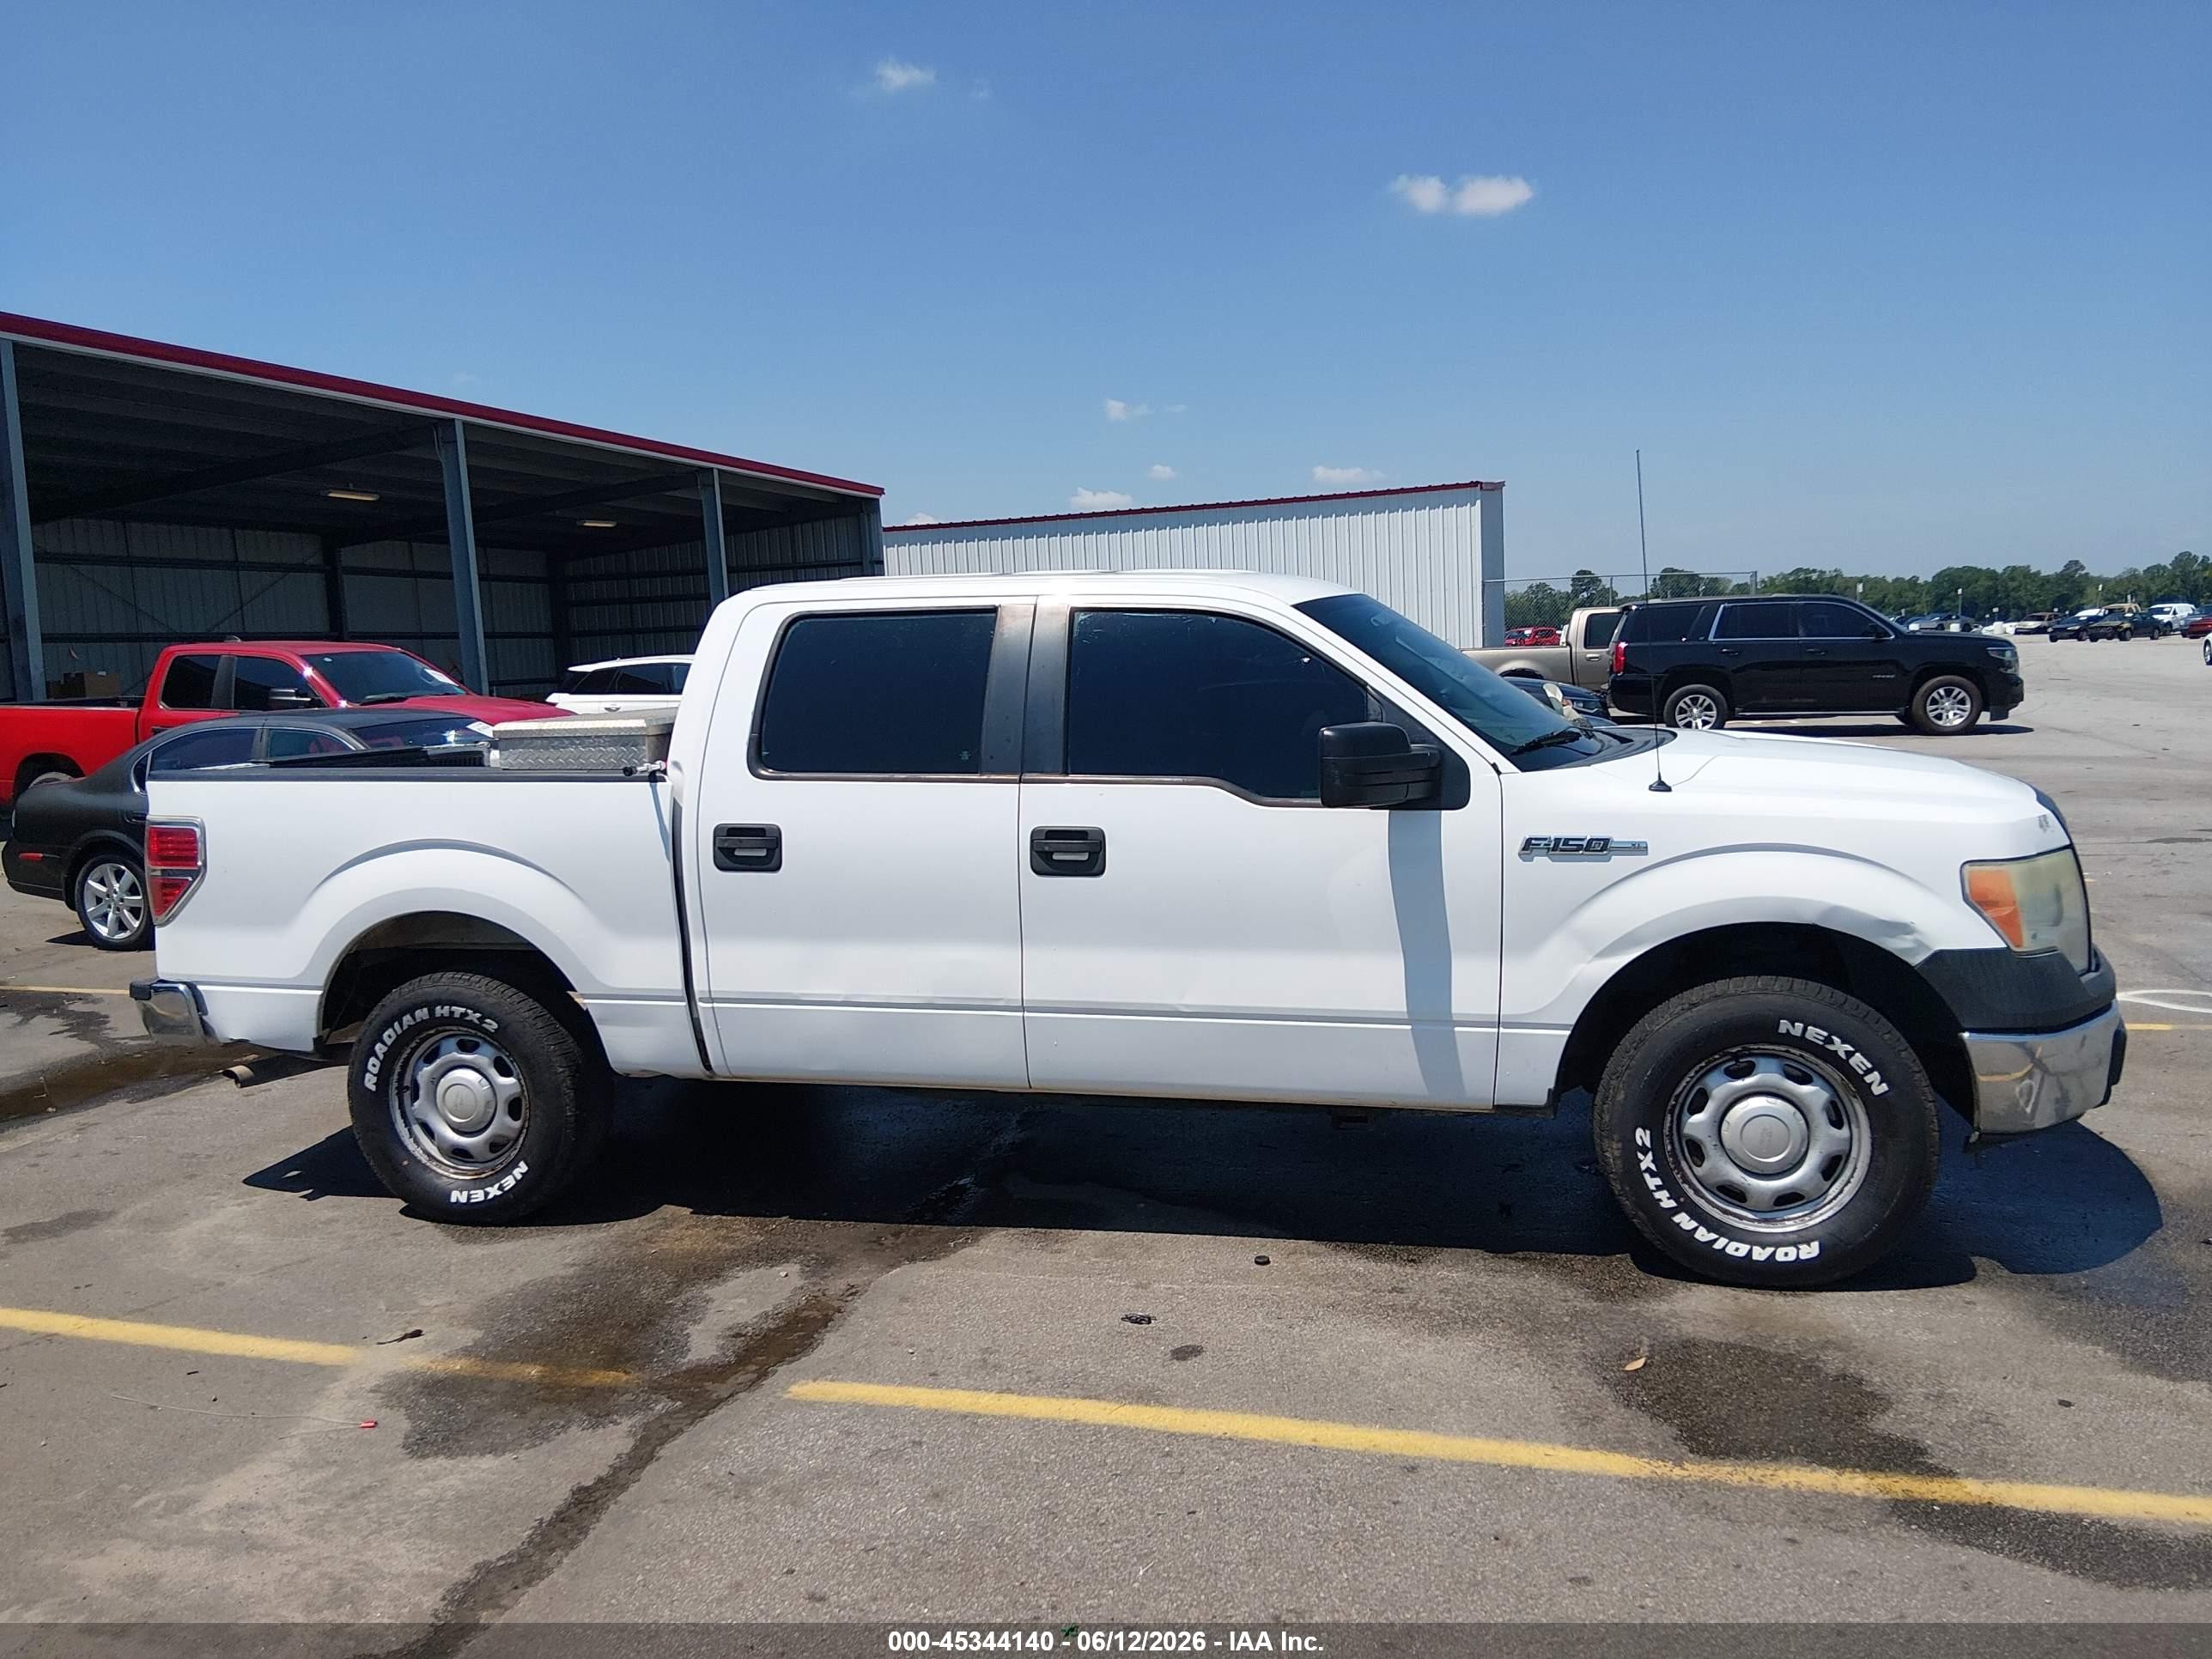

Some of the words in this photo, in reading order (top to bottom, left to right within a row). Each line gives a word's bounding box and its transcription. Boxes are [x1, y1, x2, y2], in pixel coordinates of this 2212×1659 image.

[1520, 836, 1612, 855] F-150
[364, 1007, 430, 1092] ROADIAN
[434, 1006, 499, 1033] HTX2
[1778, 1019, 1889, 1097] NEXEN
[450, 1160, 529, 1203] NEXEN
[1635, 1127, 1678, 1209] HTX2
[1672, 1212, 1820, 1262] ROADIAN
